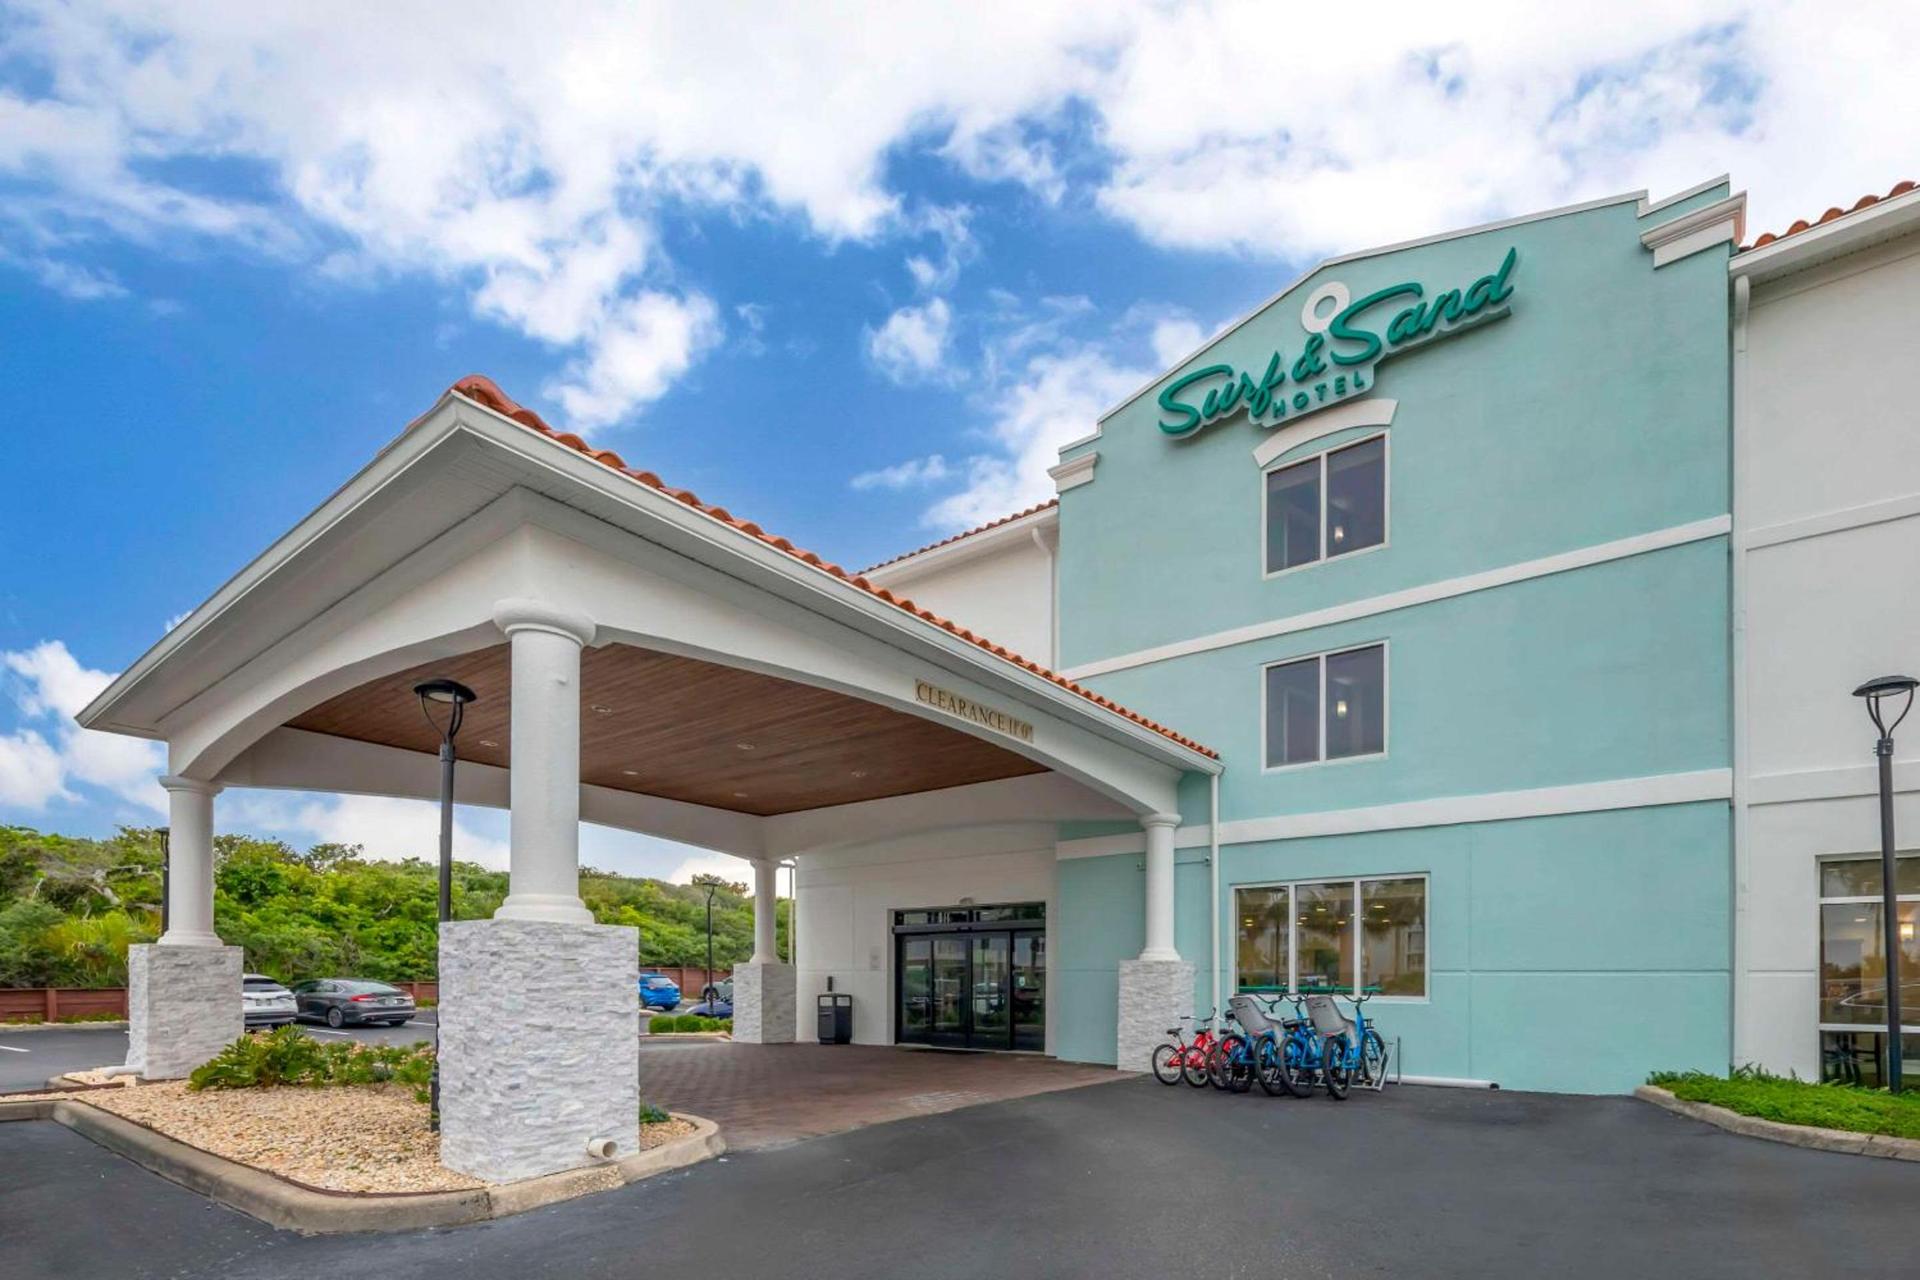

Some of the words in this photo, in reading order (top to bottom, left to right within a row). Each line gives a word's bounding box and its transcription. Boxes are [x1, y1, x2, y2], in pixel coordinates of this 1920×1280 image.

[1158, 351, 1286, 434] Surf
[1291, 333, 1328, 383] &
[1329, 247, 1516, 365] Sand
[1273, 370, 1365, 418] HOTEL
[917, 682, 1005, 731] CLEARANCE
